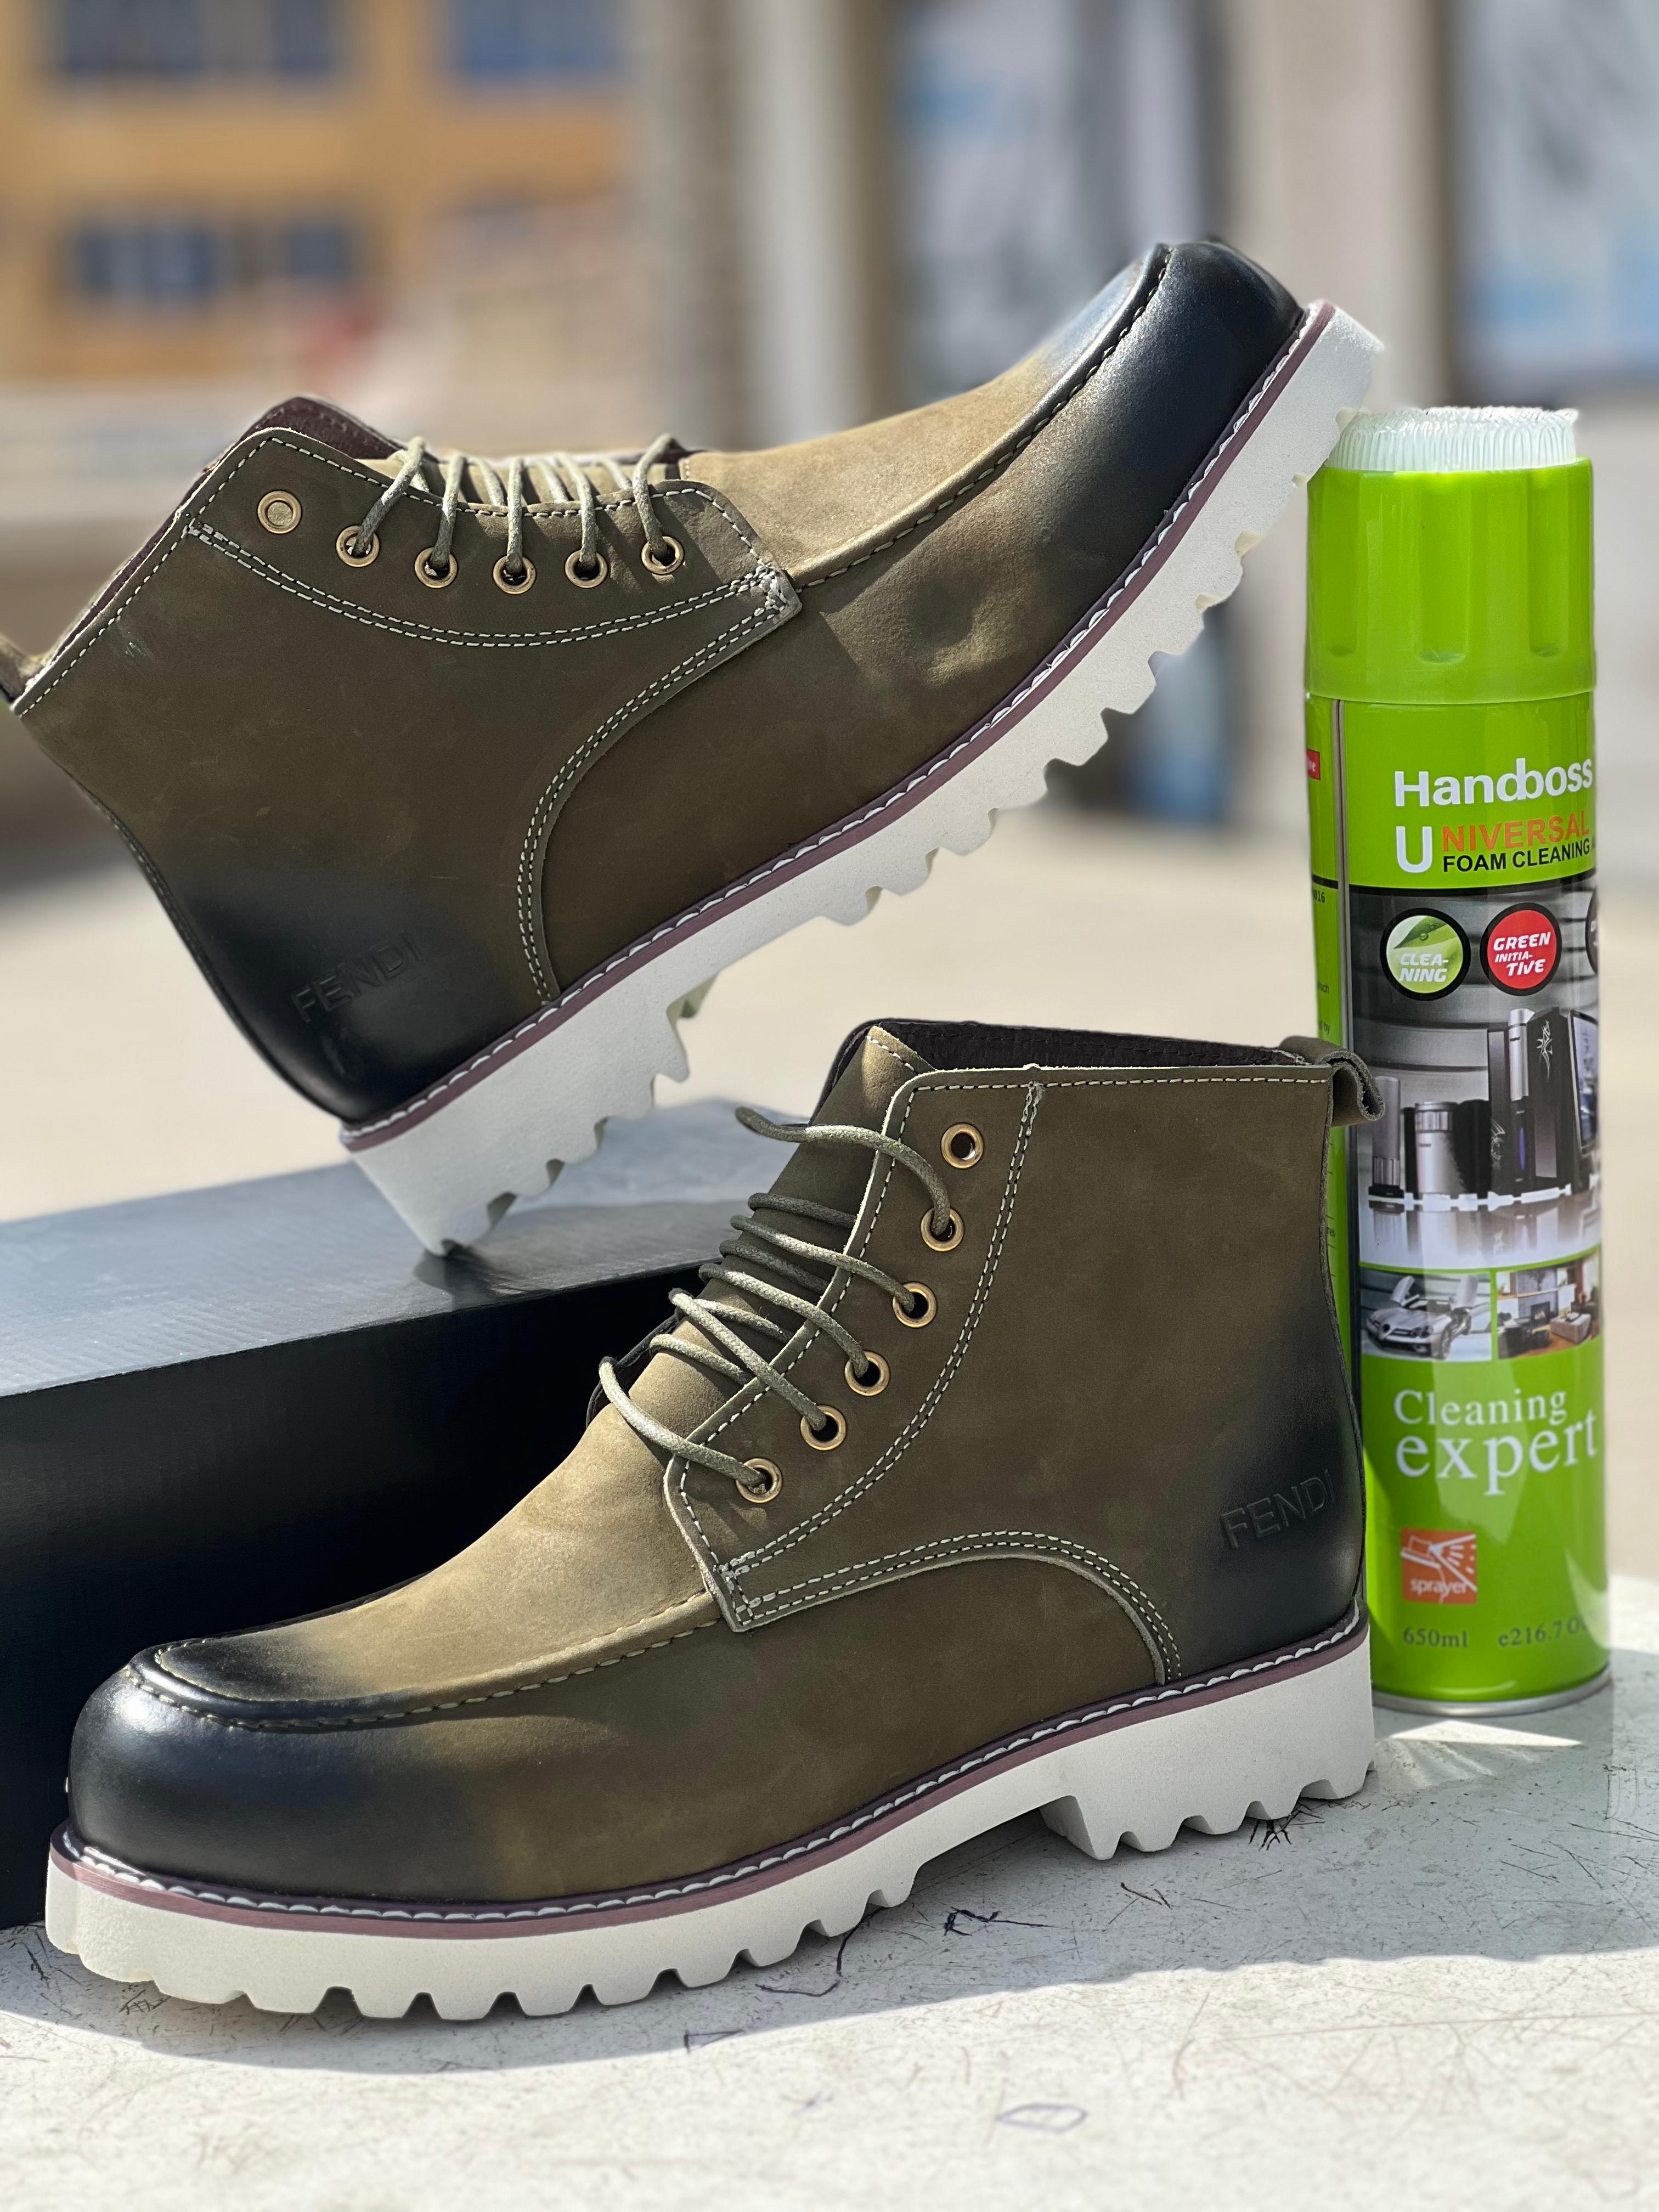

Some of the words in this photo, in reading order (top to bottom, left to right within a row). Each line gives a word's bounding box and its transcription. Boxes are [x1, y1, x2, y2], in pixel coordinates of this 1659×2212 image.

[1395, 757, 1593, 806] Handboss
[1443, 853, 1506, 872] FOAM
[1512, 838, 1590, 868] CLEANING
[1493, 932, 1551, 951] GREEN
[1400, 953, 1449, 966] CLEA-
[1494, 951, 1533, 963] INITIA-
[1506, 958, 1546, 977] TIVE
[290, 932, 425, 1023] FENDI
[1399, 968, 1447, 983] NING
[1393, 1388, 1567, 1426] Cleaning
[1395, 1408, 1598, 1496] expert
[1218, 1469, 1335, 1550] FENDI
[1409, 1578, 1467, 1598] sprayer
[1403, 1626, 1468, 1648] 650ml
